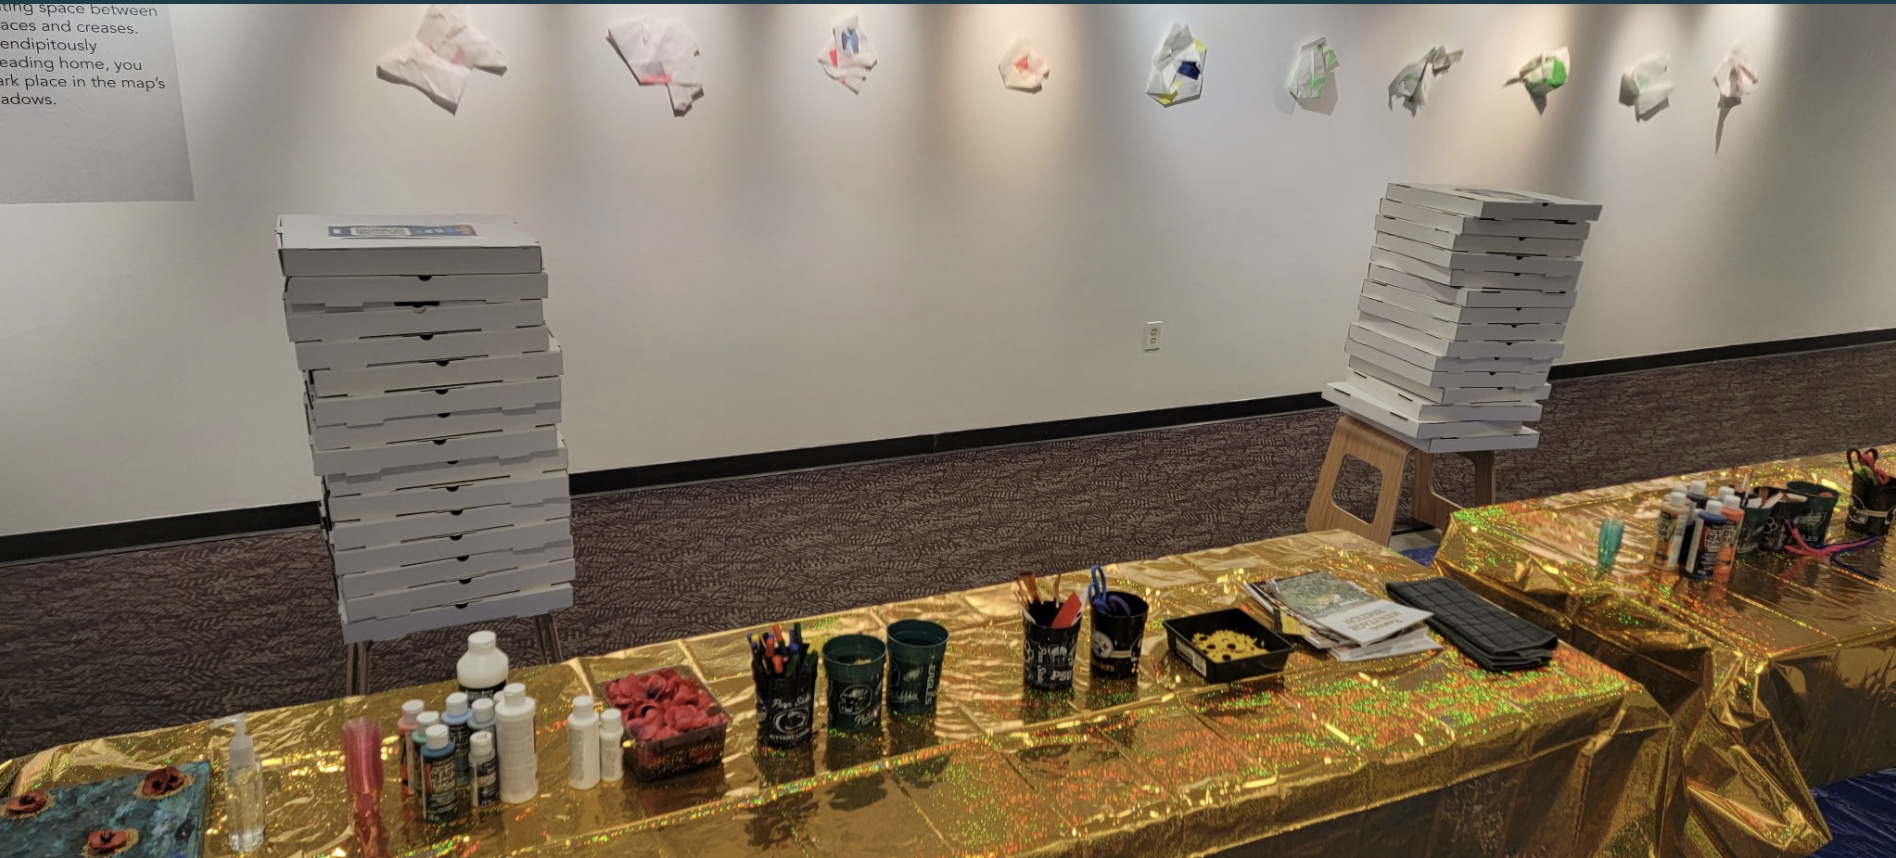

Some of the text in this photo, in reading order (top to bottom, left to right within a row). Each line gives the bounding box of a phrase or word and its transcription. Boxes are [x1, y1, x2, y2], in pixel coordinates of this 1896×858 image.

[0, 4, 158, 17] ting space between
[0, 20, 139, 34] aces and creases.
[0, 37, 97, 54] endipitously
[0, 56, 142, 73] eading home, you
[25, 74, 67, 90] place
[72, 76, 86, 88] in
[91, 75, 117, 88] the
[121, 77, 165, 92] map's
[1, 92, 57, 104] adows.
[1050, 670, 1073, 681] PSU
